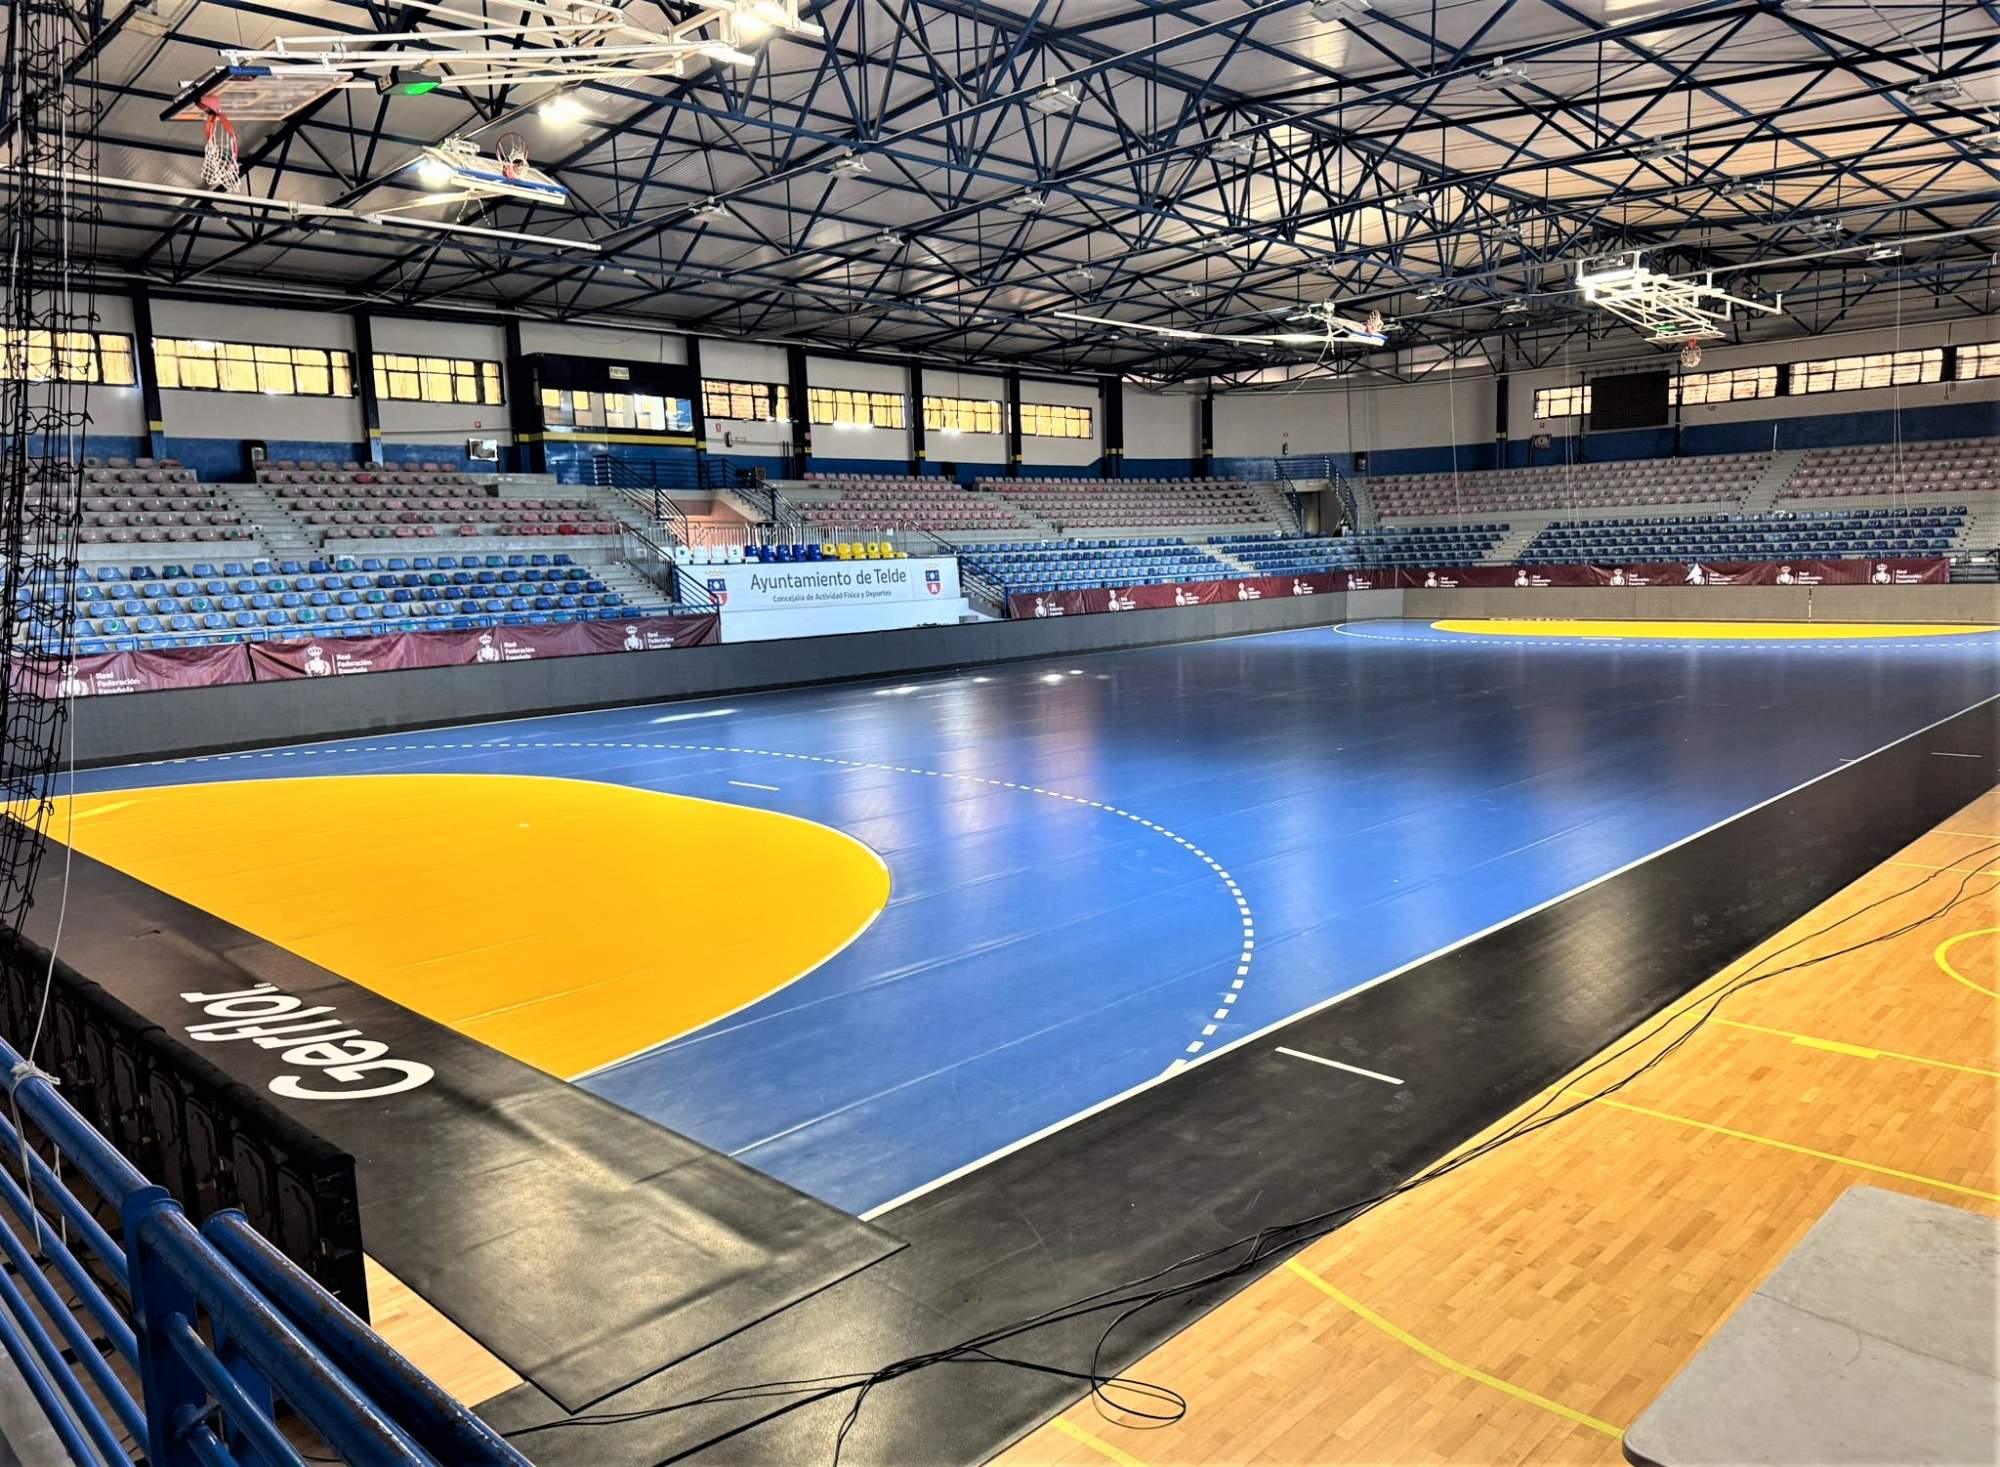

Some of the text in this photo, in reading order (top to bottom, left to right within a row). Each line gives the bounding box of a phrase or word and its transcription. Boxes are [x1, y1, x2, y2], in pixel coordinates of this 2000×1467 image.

[751, 568, 907, 593] Ayuntamiento de Telde
[806, 593, 814, 601] de
[815, 592, 843, 600] Actividad
[865, 590, 892, 599] Deportes
[180, 985, 435, 1100] Gerflor
